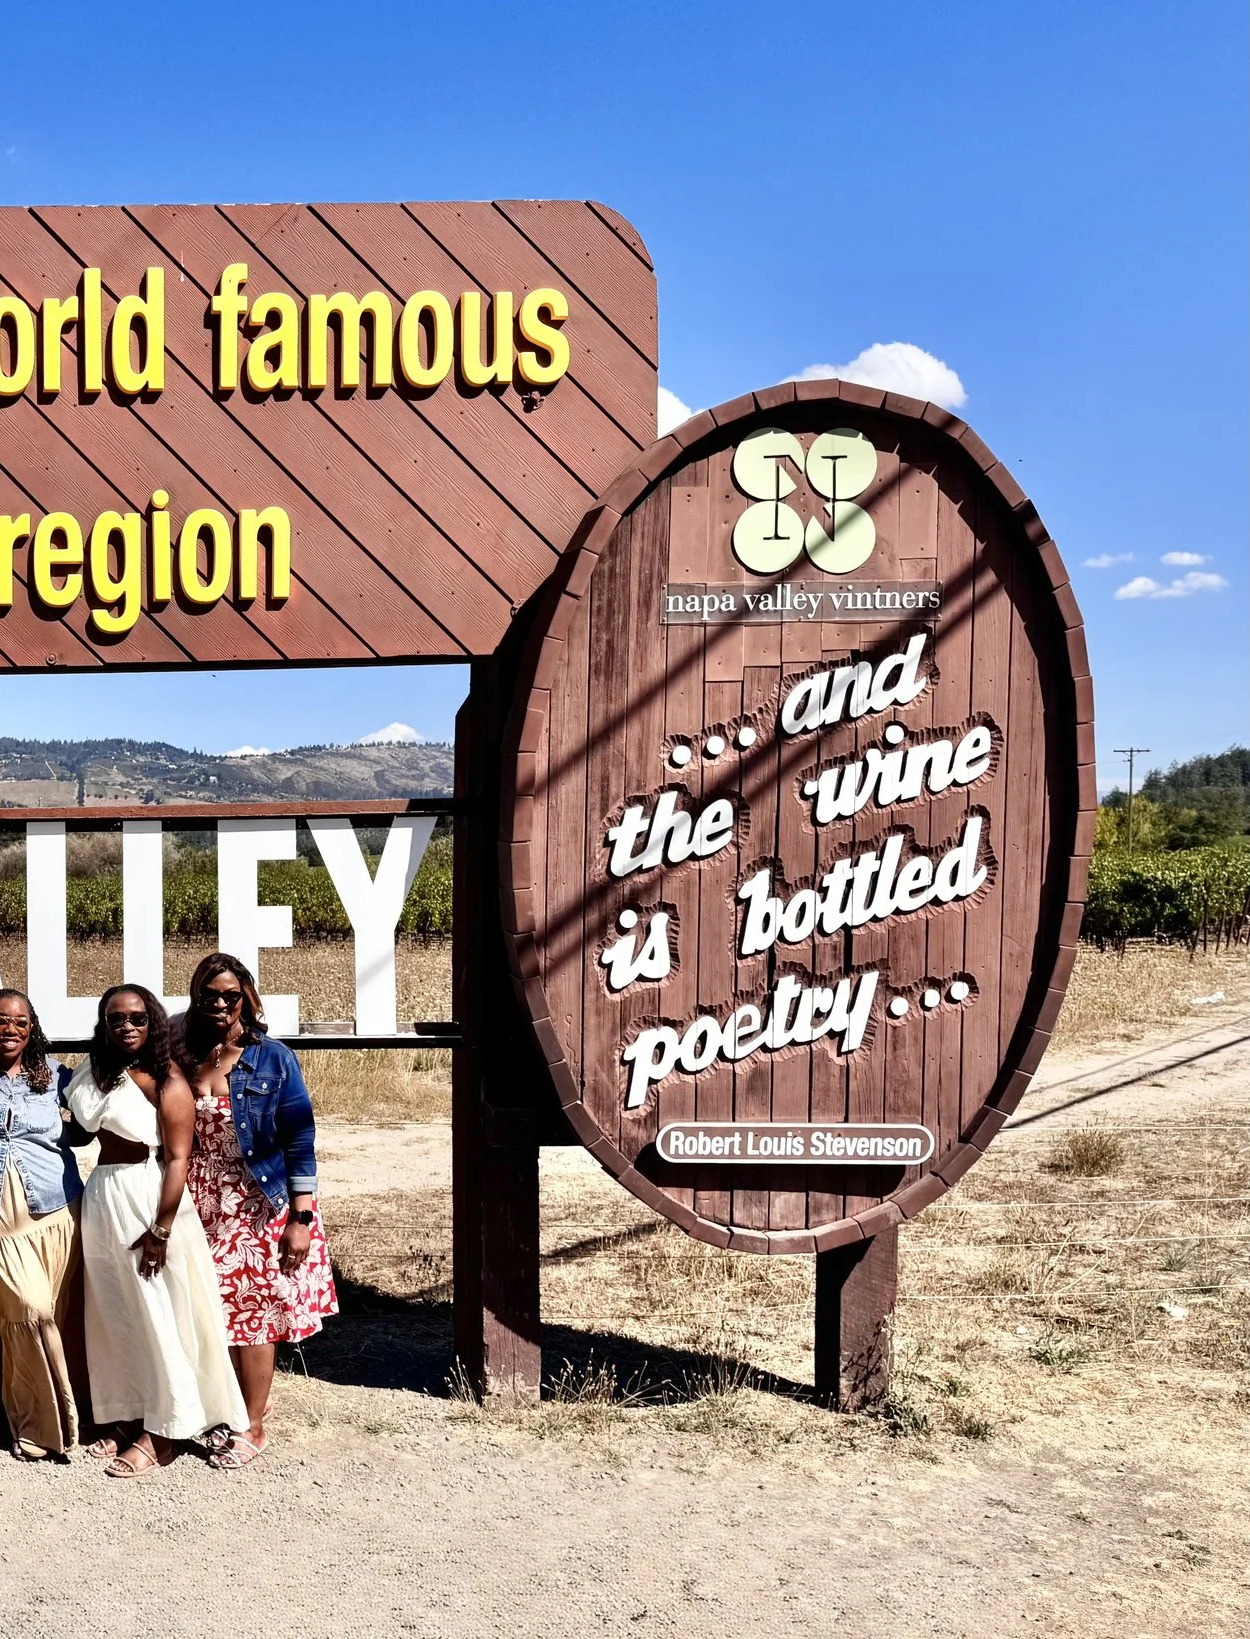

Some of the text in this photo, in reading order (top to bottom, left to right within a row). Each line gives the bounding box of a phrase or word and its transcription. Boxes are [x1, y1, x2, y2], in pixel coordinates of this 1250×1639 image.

[212, 263, 571, 390] famous
[666, 583, 940, 621] napa valley vintners
[608, 724, 992, 877] the wine
[602, 816, 988, 990] is bottled
[669, 1131, 922, 1157] Robert Louis Stevenson
